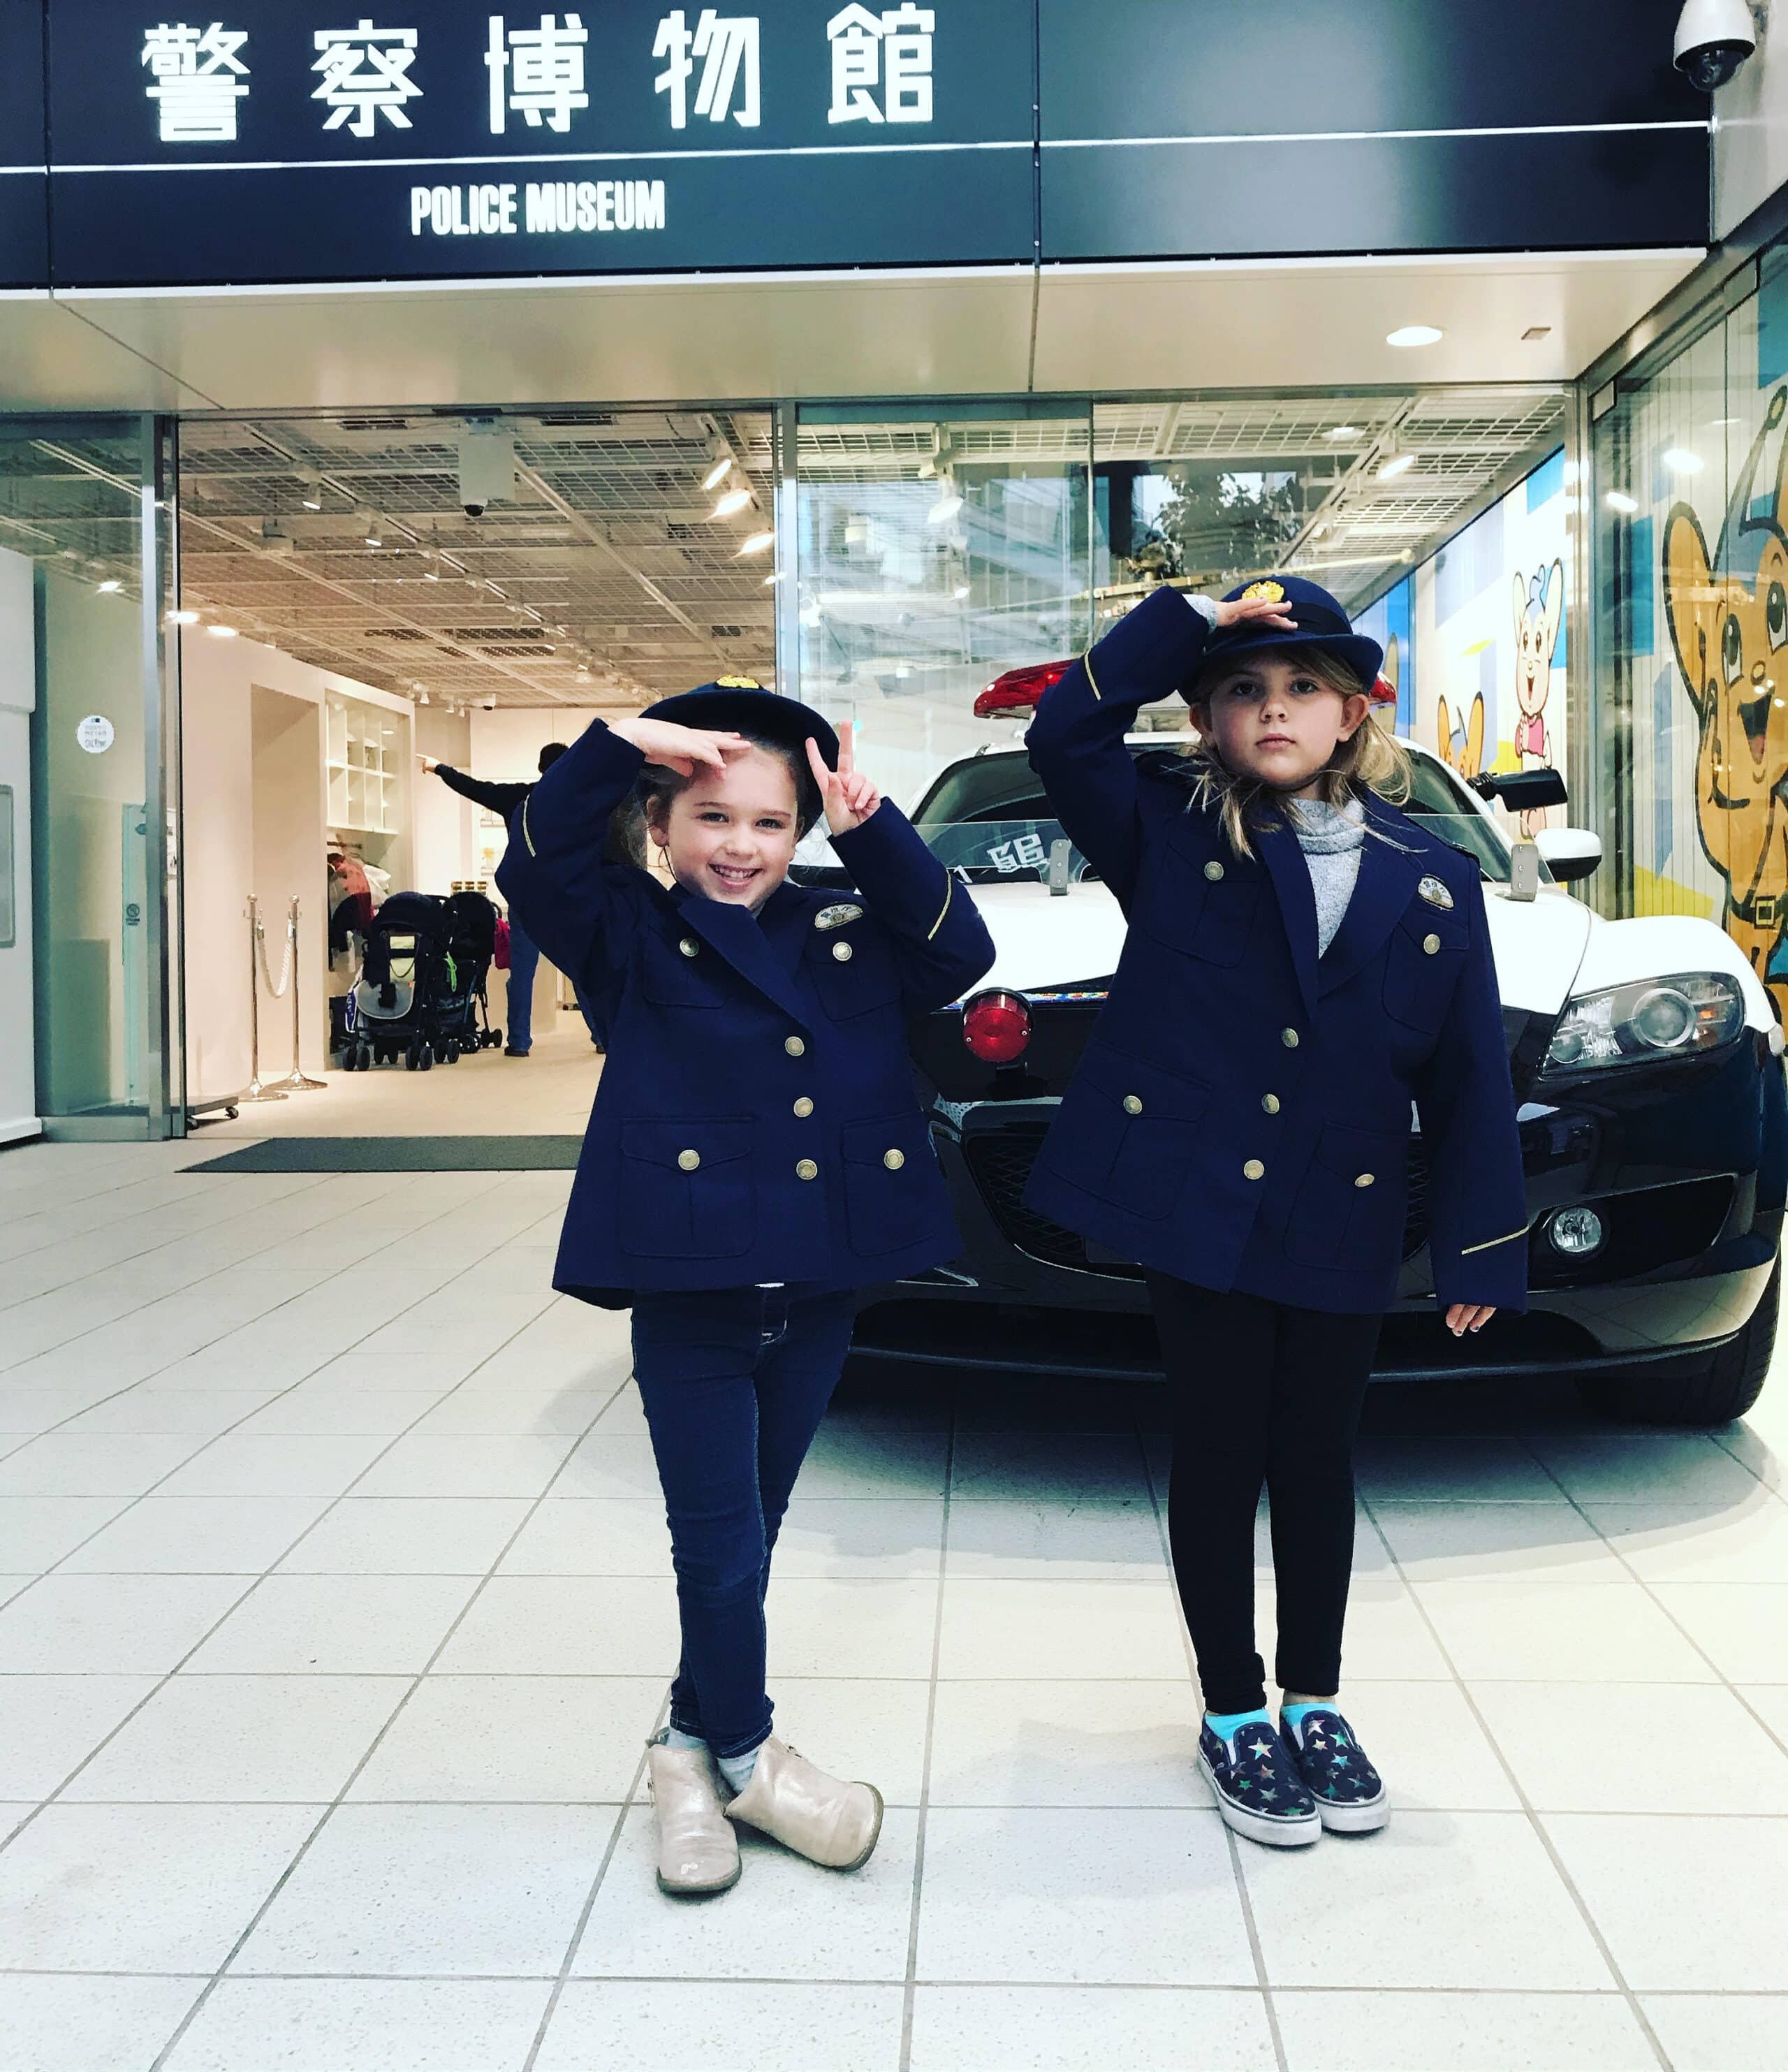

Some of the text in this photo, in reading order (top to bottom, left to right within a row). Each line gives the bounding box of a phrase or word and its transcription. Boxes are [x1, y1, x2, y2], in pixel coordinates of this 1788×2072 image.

[142, 2, 936, 142] 警察博物館
[411, 180, 666, 235] POLICE MUSEUM
